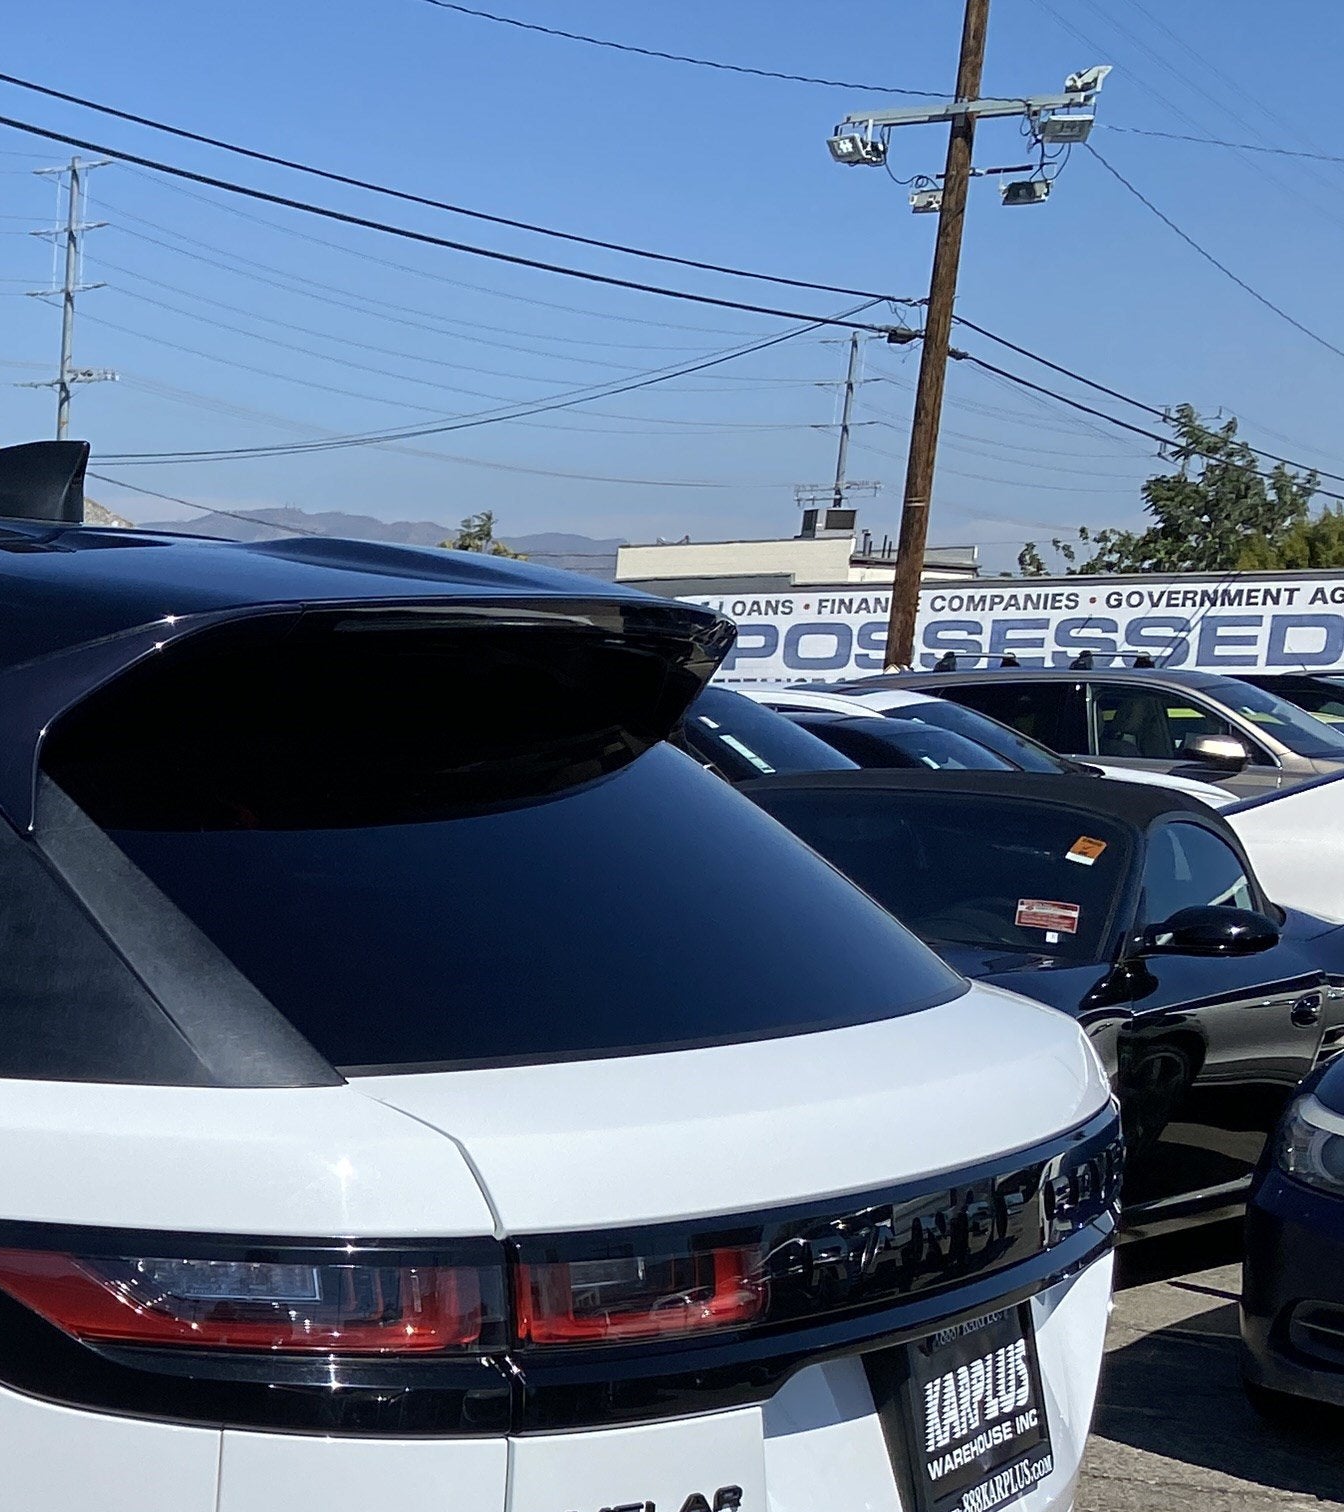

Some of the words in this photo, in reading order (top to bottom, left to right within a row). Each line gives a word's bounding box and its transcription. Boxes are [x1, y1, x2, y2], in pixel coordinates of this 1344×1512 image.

[817, 597, 920, 616] FINAN
[929, 591, 1080, 612] COMPANIES
[1105, 587, 1300, 609] GOVERNMENT
[923, 1338, 1030, 1453] KARPLUS
[926, 1421, 1012, 1481] WAREHOUSE
[1015, 1408, 1039, 1436] INC
